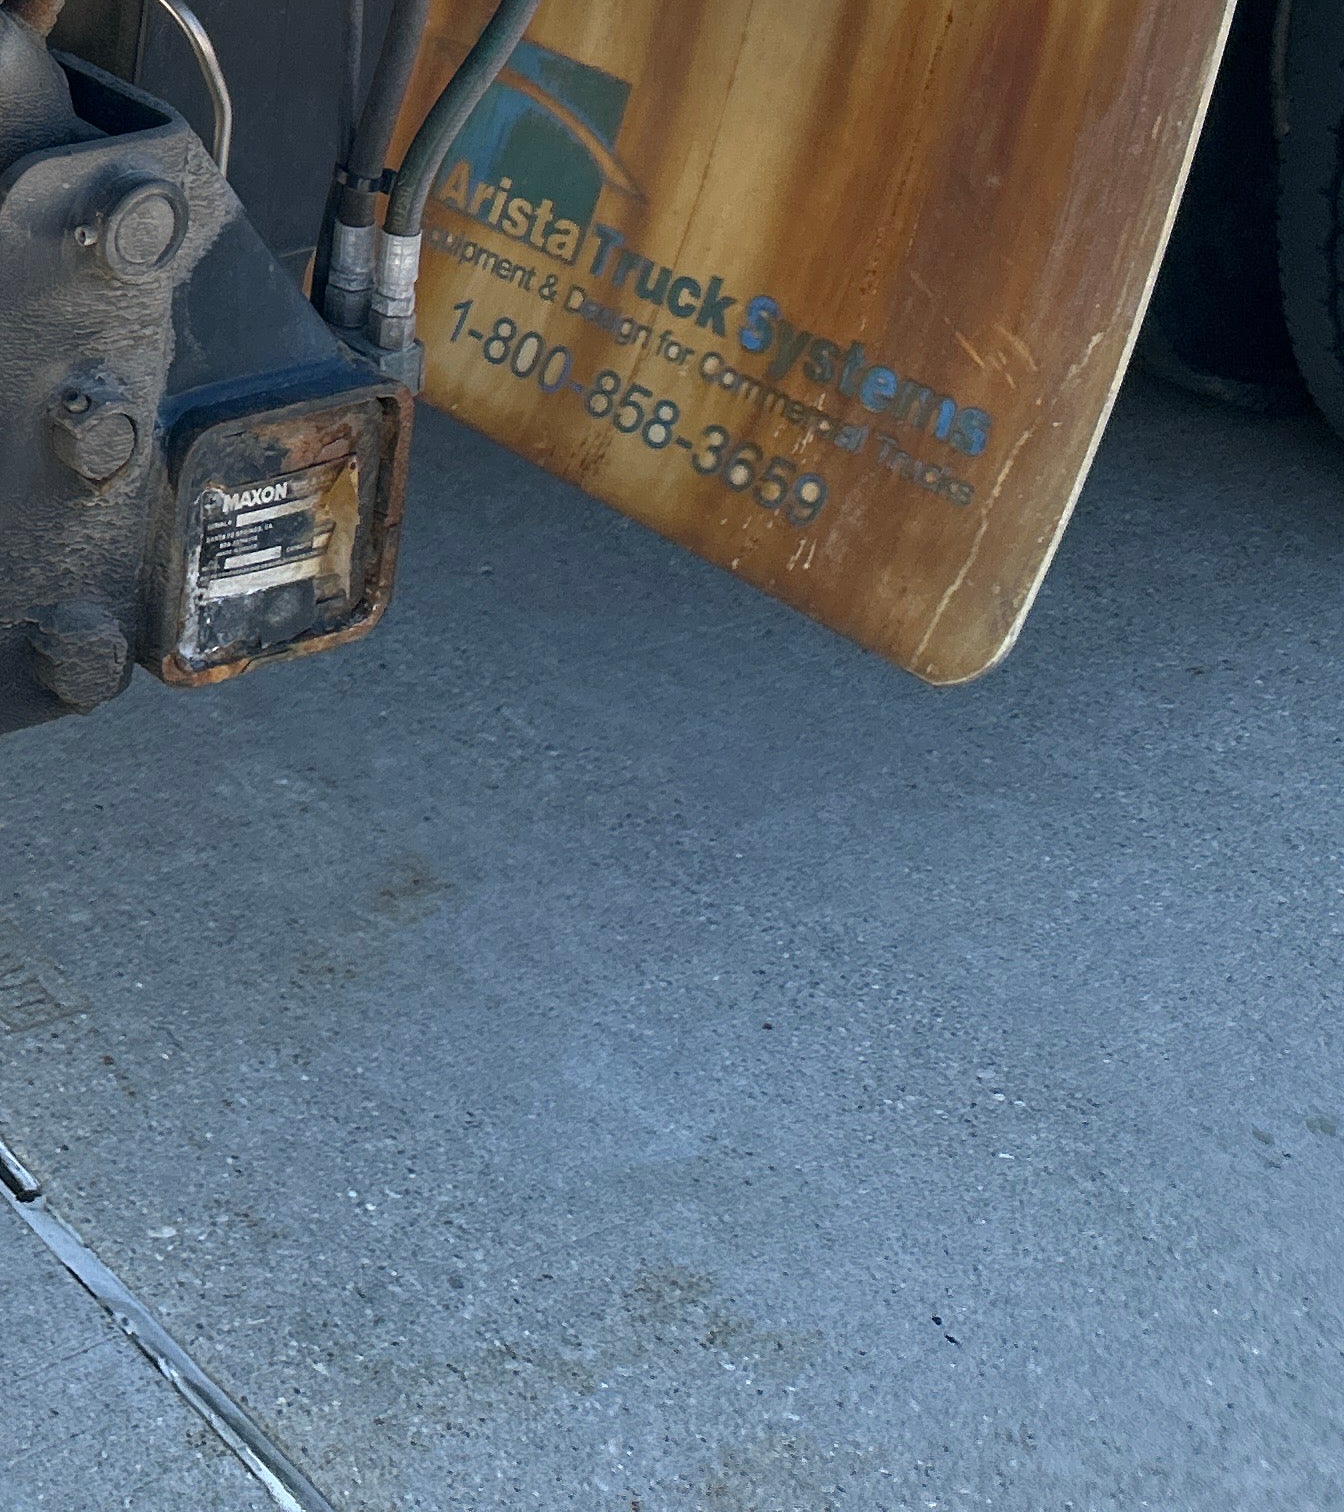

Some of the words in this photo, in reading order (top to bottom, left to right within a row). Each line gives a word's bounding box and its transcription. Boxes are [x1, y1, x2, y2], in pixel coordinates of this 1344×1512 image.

[439, 160, 580, 263] Arista
[590, 222, 736, 338] Truck
[739, 295, 992, 456] Systems
[539, 273, 558, 303] &
[564, 284, 653, 348] Design
[656, 330, 695, 365] for
[450, 299, 830, 528] 1-800-858-3659
[222, 482, 288, 513] MAXON
